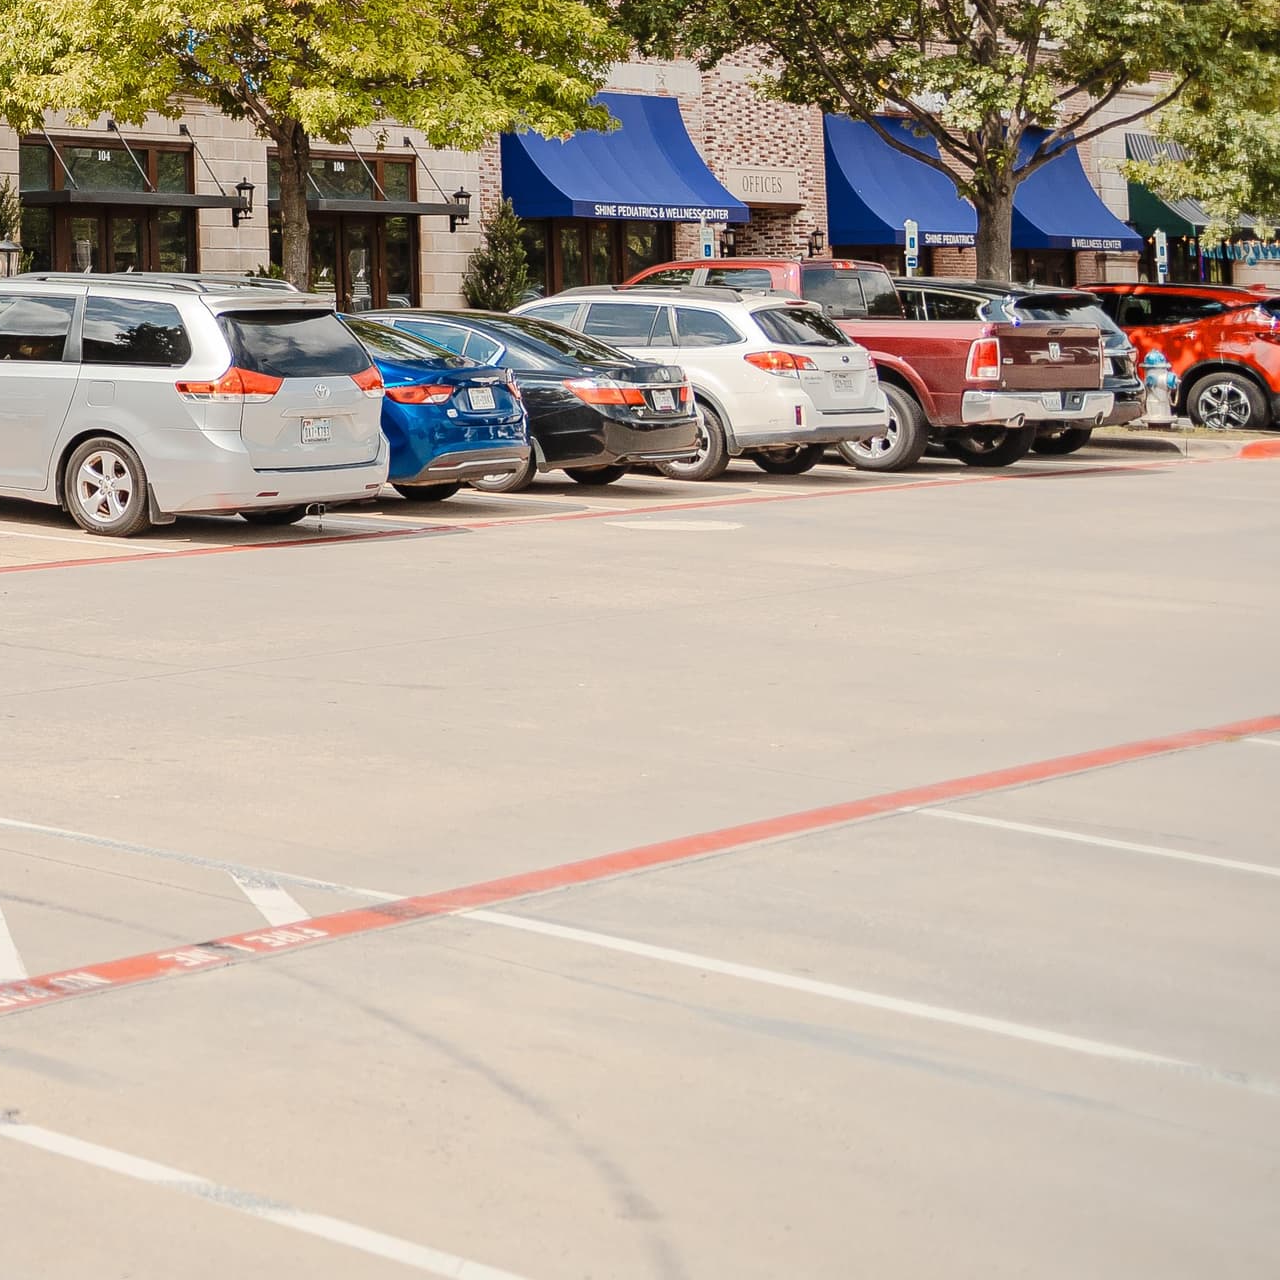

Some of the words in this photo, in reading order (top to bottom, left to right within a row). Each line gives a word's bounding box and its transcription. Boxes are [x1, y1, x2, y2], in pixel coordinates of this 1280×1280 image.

[97, 151, 111, 162] 104
[742, 175, 783, 194] OFFICES
[594, 204, 617, 217] SHINE
[617, 205, 658, 219] PEDIATRICS
[659, 207, 665, 218] &
[666, 207, 702, 220] WELLNESS
[702, 209, 729, 220] CENTER
[925, 233, 942, 244] SHINE
[942, 234, 975, 245] PEDIATRICS
[1071, 238, 1076, 248] &
[1077, 238, 1103, 249] WELLNESS
[1103, 239, 1122, 250] CENTER
